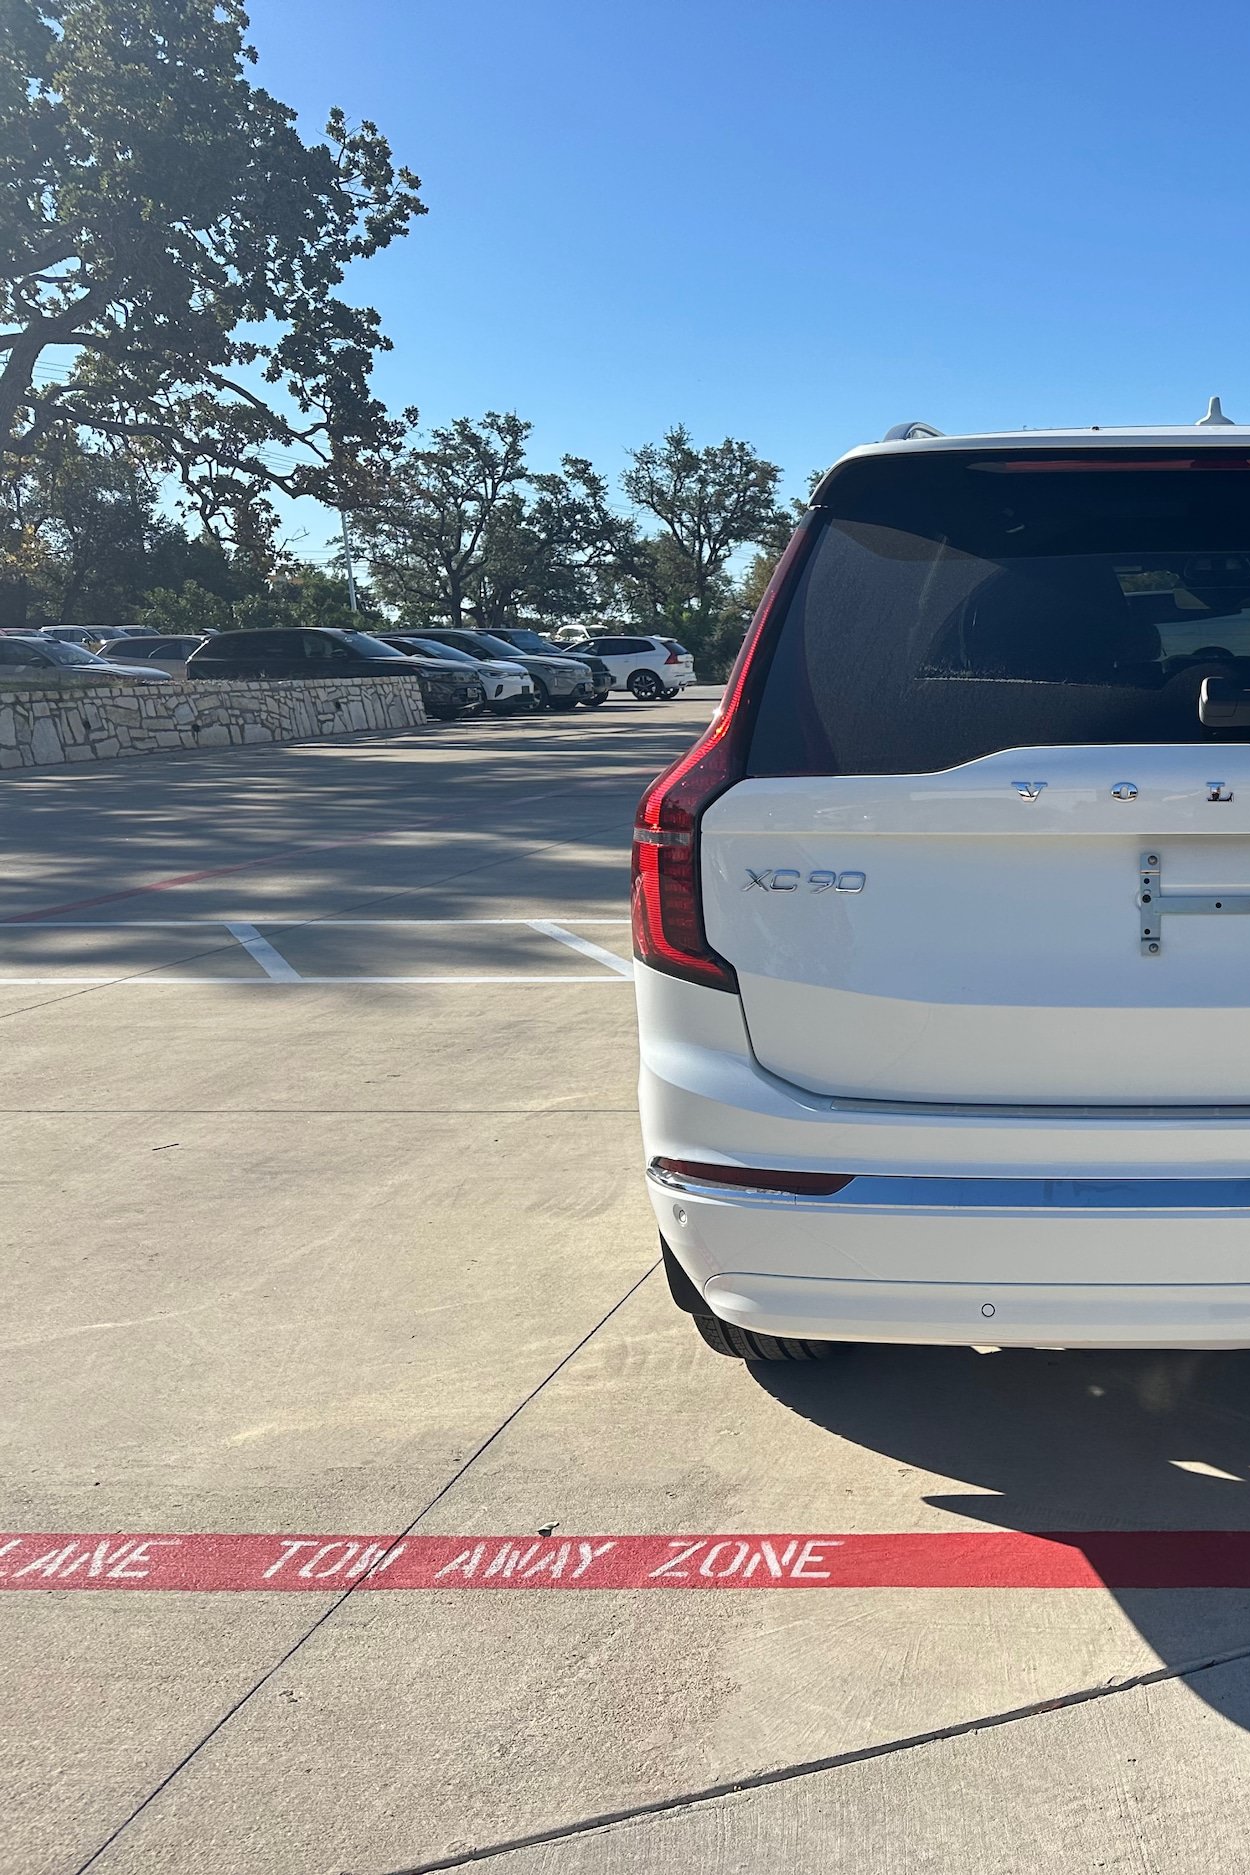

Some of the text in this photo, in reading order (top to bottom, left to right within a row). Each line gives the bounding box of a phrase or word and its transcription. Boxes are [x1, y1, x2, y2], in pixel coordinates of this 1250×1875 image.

[262, 1539, 407, 1579] TOW
[433, 1540, 618, 1579] AWAY
[648, 1538, 846, 1579] ZONE
